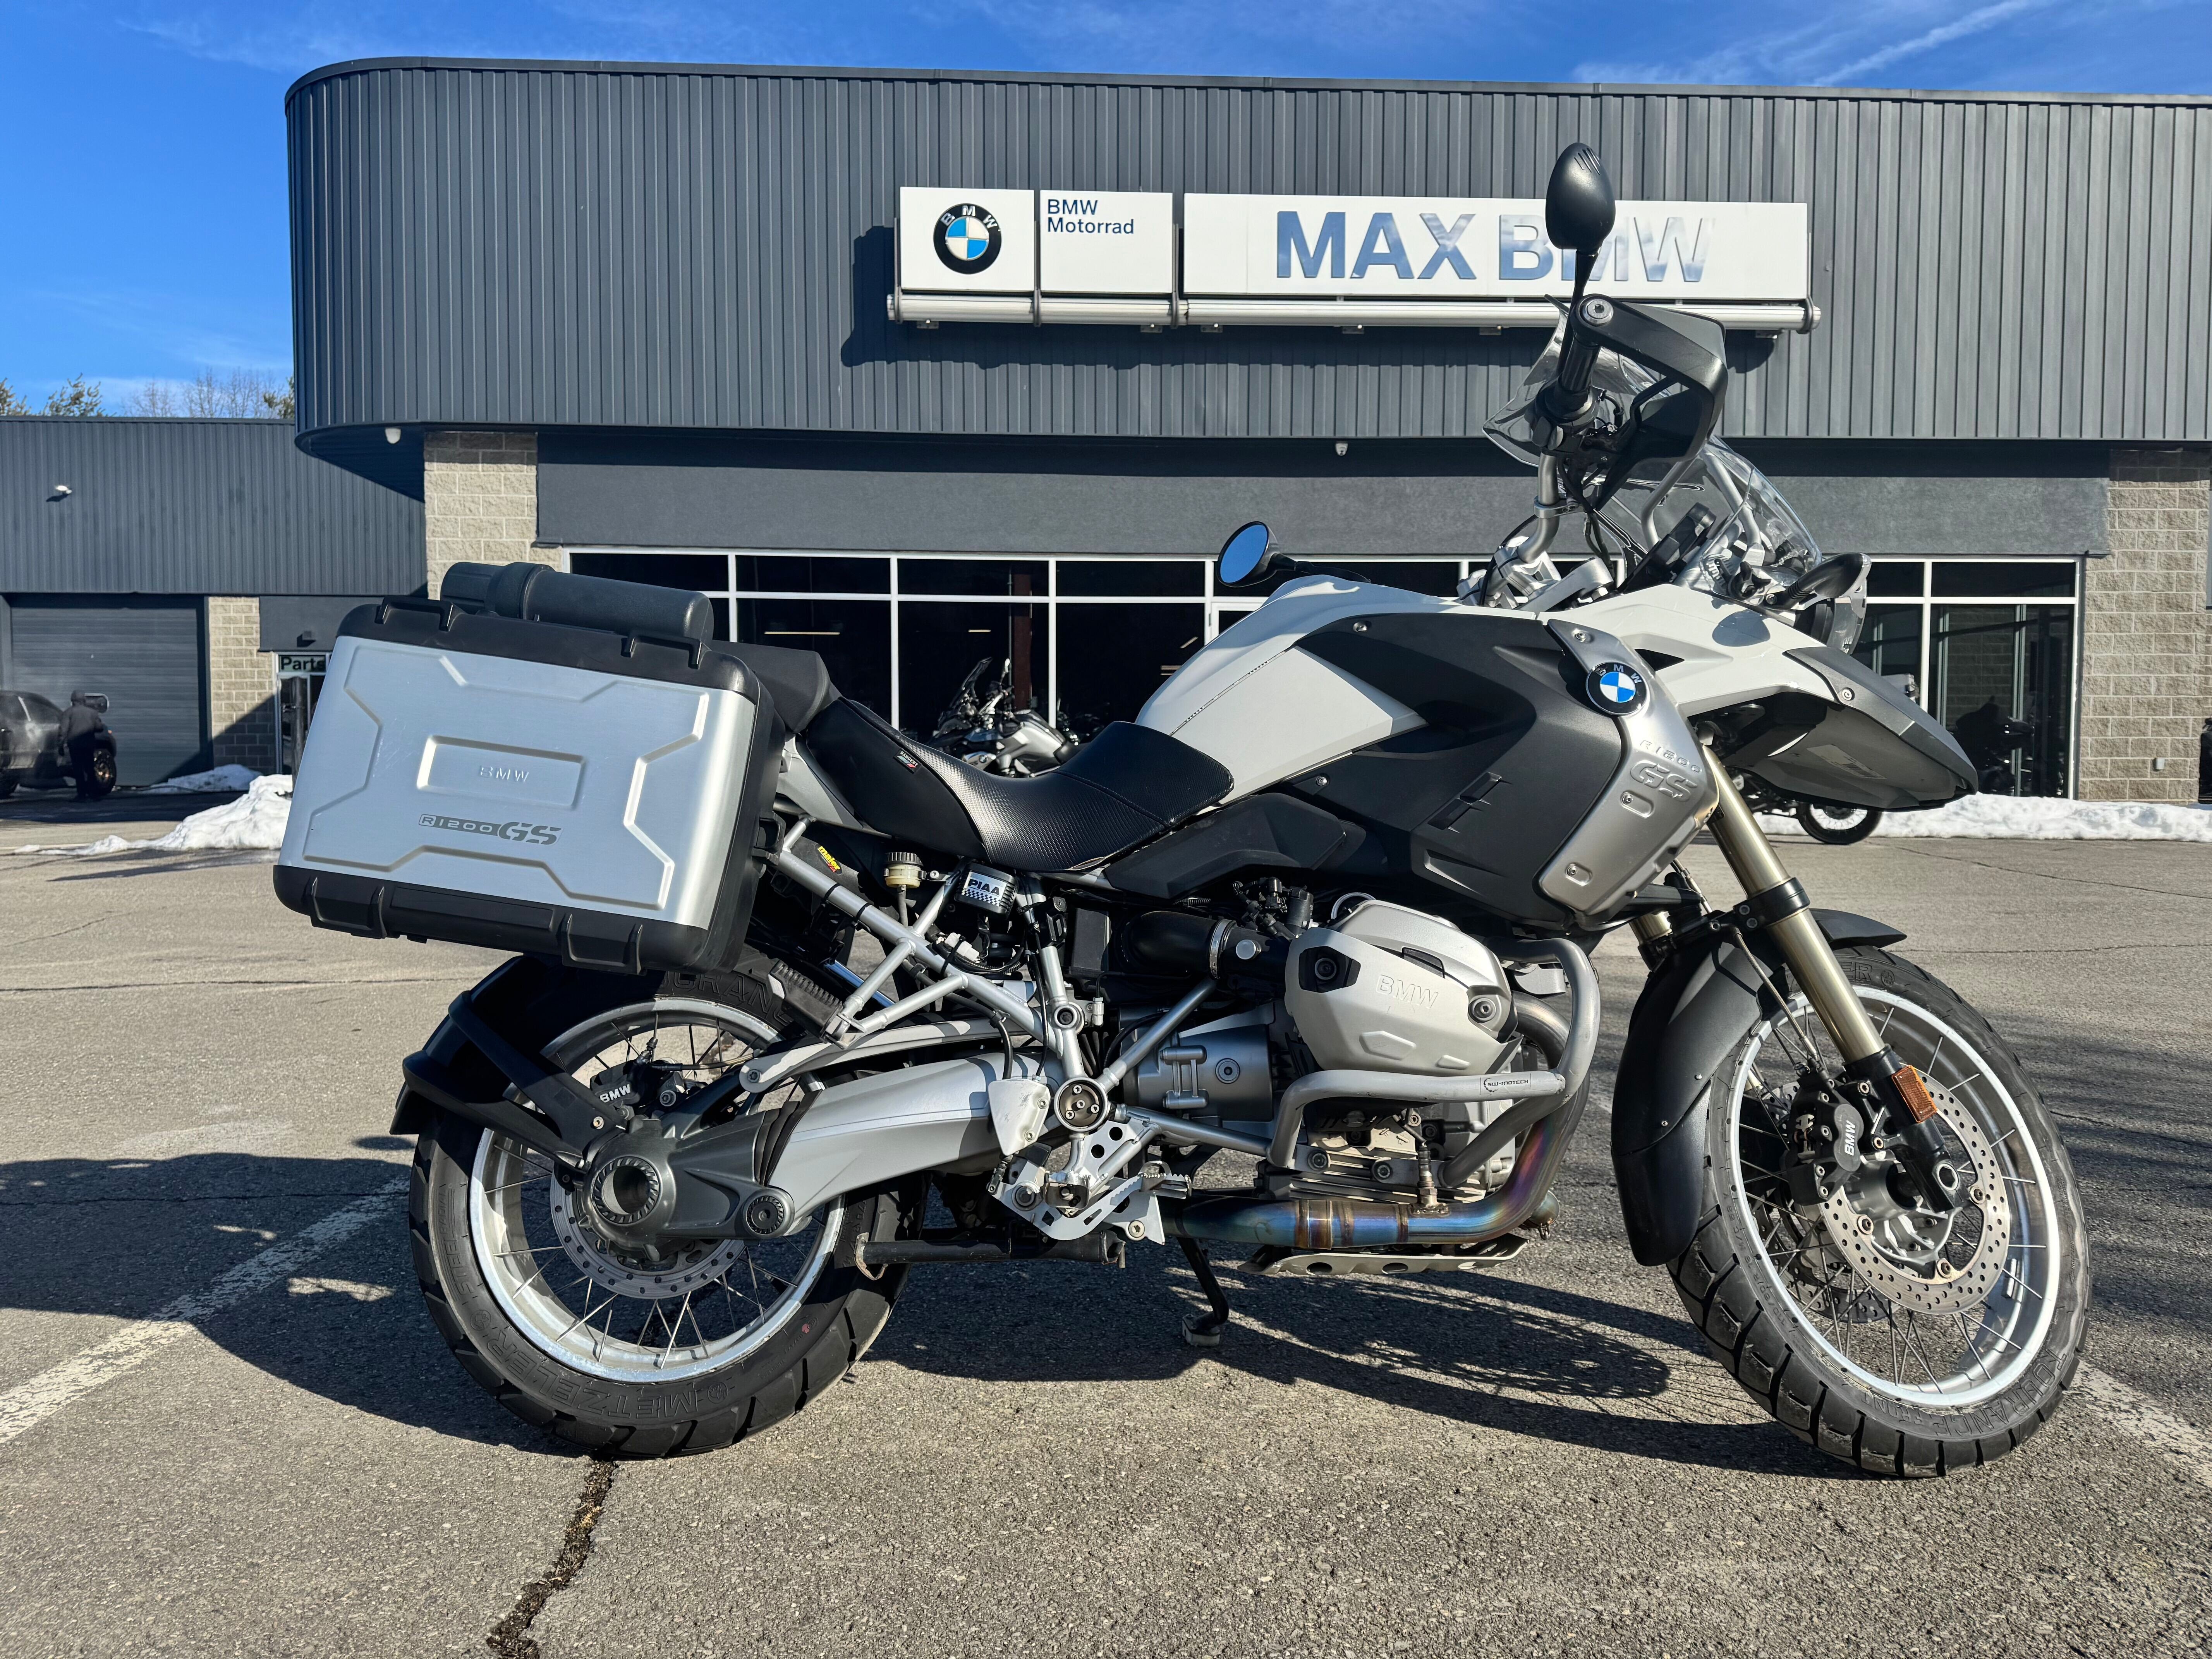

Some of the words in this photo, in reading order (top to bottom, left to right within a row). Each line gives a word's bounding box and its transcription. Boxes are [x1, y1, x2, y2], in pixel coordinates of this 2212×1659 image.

[940, 205, 998, 229] BMW
[1048, 199, 1098, 215] BMW
[1048, 217, 1134, 234] Motorrad
[1277, 211, 1477, 280] MAX
[281, 657, 326, 670] Parts
[1595, 664, 1642, 684] BMW
[480, 765, 529, 783] BMW
[1630, 760, 1697, 802] GS
[818, 846, 840, 870] maier
[968, 879, 1000, 896] PIAA
[1376, 974, 1439, 1009] BMW
[599, 1084, 630, 1103] BMW
[1844, 1120, 1856, 1156] BMW
[486, 1329, 698, 1419] METZELER
